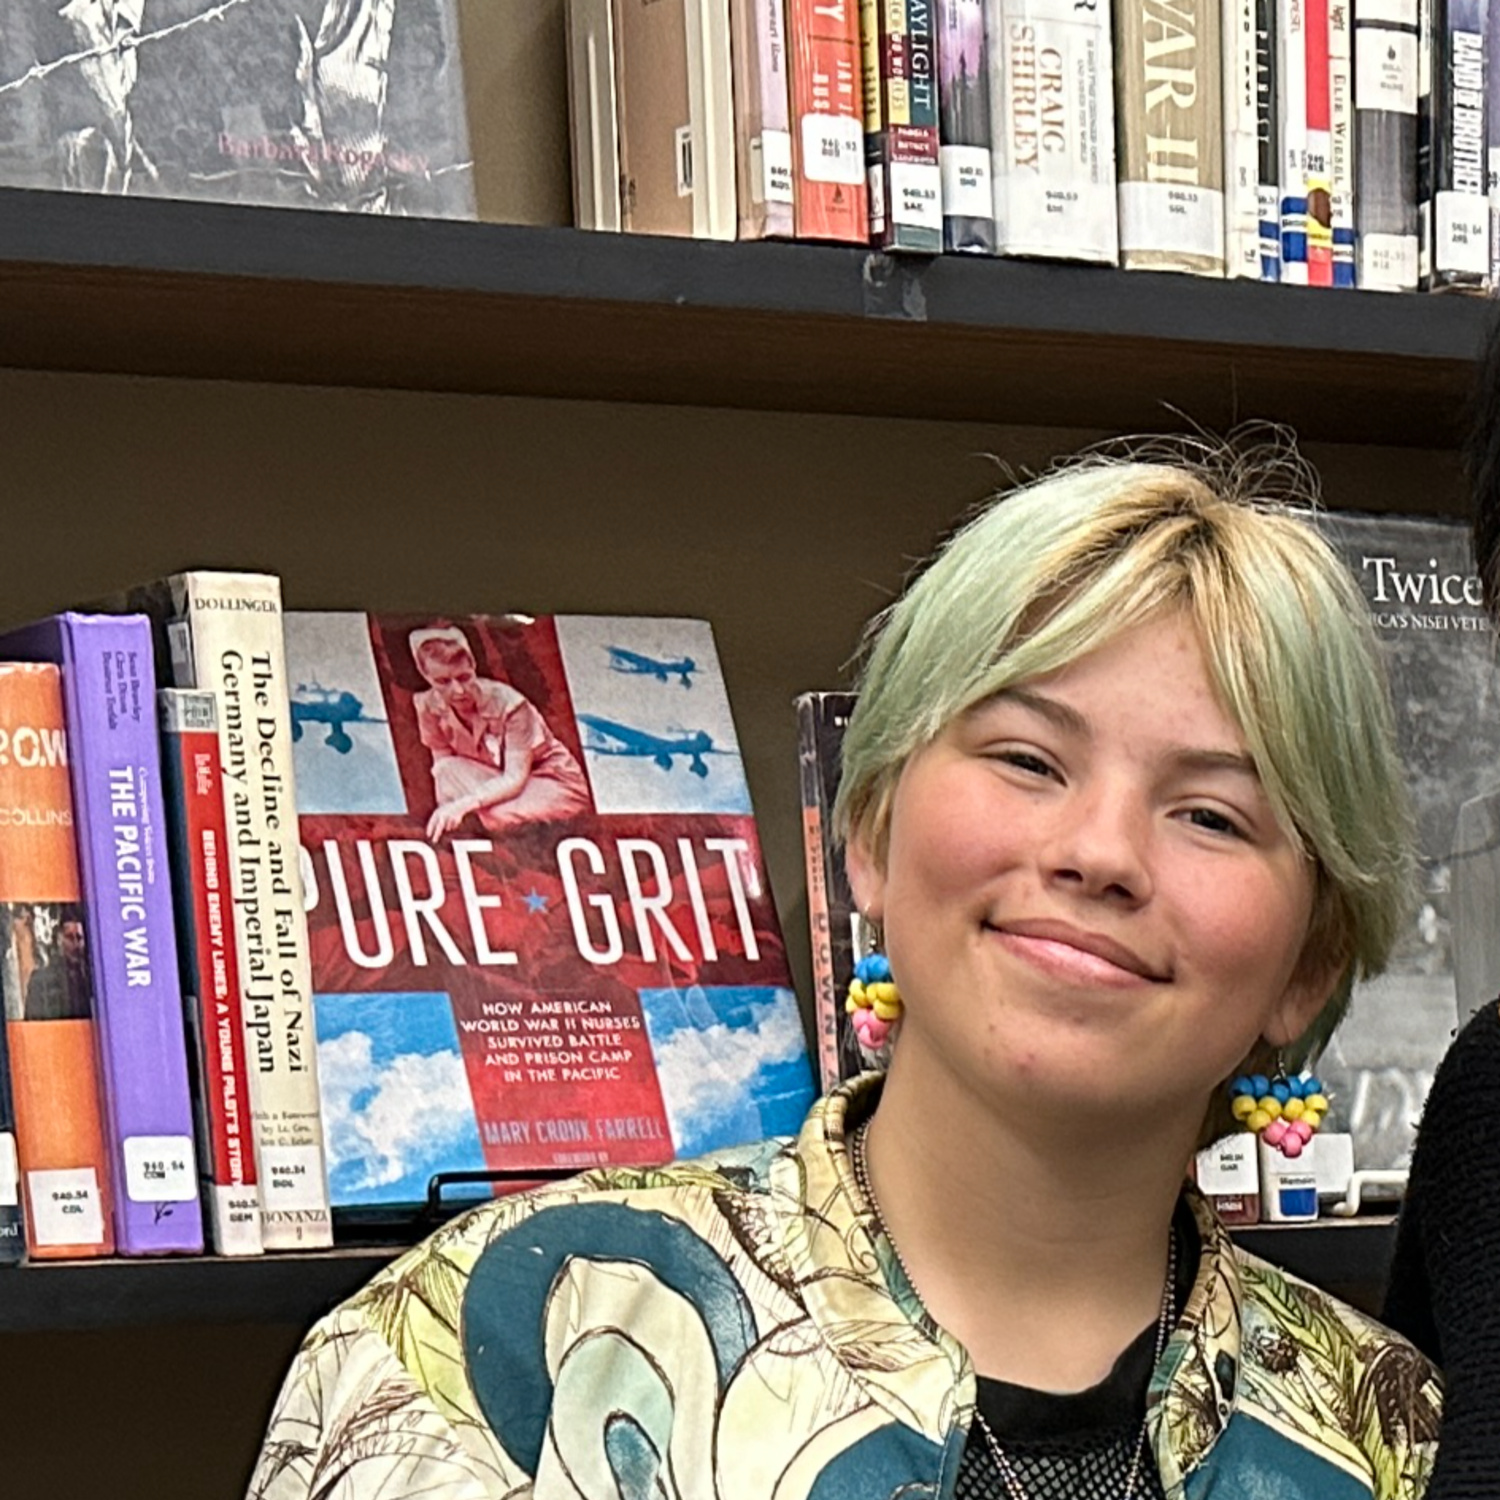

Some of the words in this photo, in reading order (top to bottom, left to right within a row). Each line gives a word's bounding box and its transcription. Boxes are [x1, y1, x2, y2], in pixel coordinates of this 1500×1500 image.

[1453, 32, 1483, 86] BAND
[1010, 24, 1040, 175] SHIRLEY
[1039, 47, 1066, 153] CRAIG
[1333, 74, 1347, 112] ELIE
[1146, 133, 1198, 186] II
[1333, 121, 1347, 184] WIESEL
[193, 597, 279, 614] DOLLINGER
[1362, 556, 1483, 607] Twice
[1411, 616, 1449, 631] NISEI
[250, 649, 274, 708] The
[221, 649, 249, 785] Germany
[108, 765, 137, 817] THE
[256, 717, 281, 831] Decline
[233, 794, 261, 849] and
[114, 823, 148, 922] PACIFIC
[201, 829, 218, 890] BEHIND
[268, 839, 292, 895] and
[206, 892, 224, 947] ENEMY
[234, 855, 274, 983] Imperial
[556, 836, 760, 968] GRIT
[123, 927, 152, 988] WAR
[272, 907, 297, 959] Fall
[280, 968, 303, 1002] of
[482, 1002, 523, 1016] HOW
[530, 1000, 612, 1015] AMERICAN
[217, 1018, 234, 1072] YOUNG
[246, 990, 275, 1074] Japan
[283, 1010, 308, 1073] Nazi
[460, 1019, 519, 1032] WORLD
[523, 1017, 559, 1032] WAR
[564, 1017, 577, 1031] II
[581, 1015, 641, 1031] NURSES
[487, 1034, 563, 1050] SURVIVED
[568, 1033, 622, 1048] BATTLE
[485, 1052, 520, 1066] AND
[525, 1051, 583, 1065] PRISON
[588, 1049, 633, 1064] CAMP
[504, 1069, 522, 1083] IN
[529, 1068, 556, 1082] THE
[562, 1066, 621, 1082] PACIFIC
[221, 1074, 239, 1135] PILOT'S
[483, 1120, 532, 1146] MARY
[535, 1118, 592, 1145] CRONK
[595, 1115, 665, 1141] FARRELL
[262, 1210, 328, 1223] BONANZA
